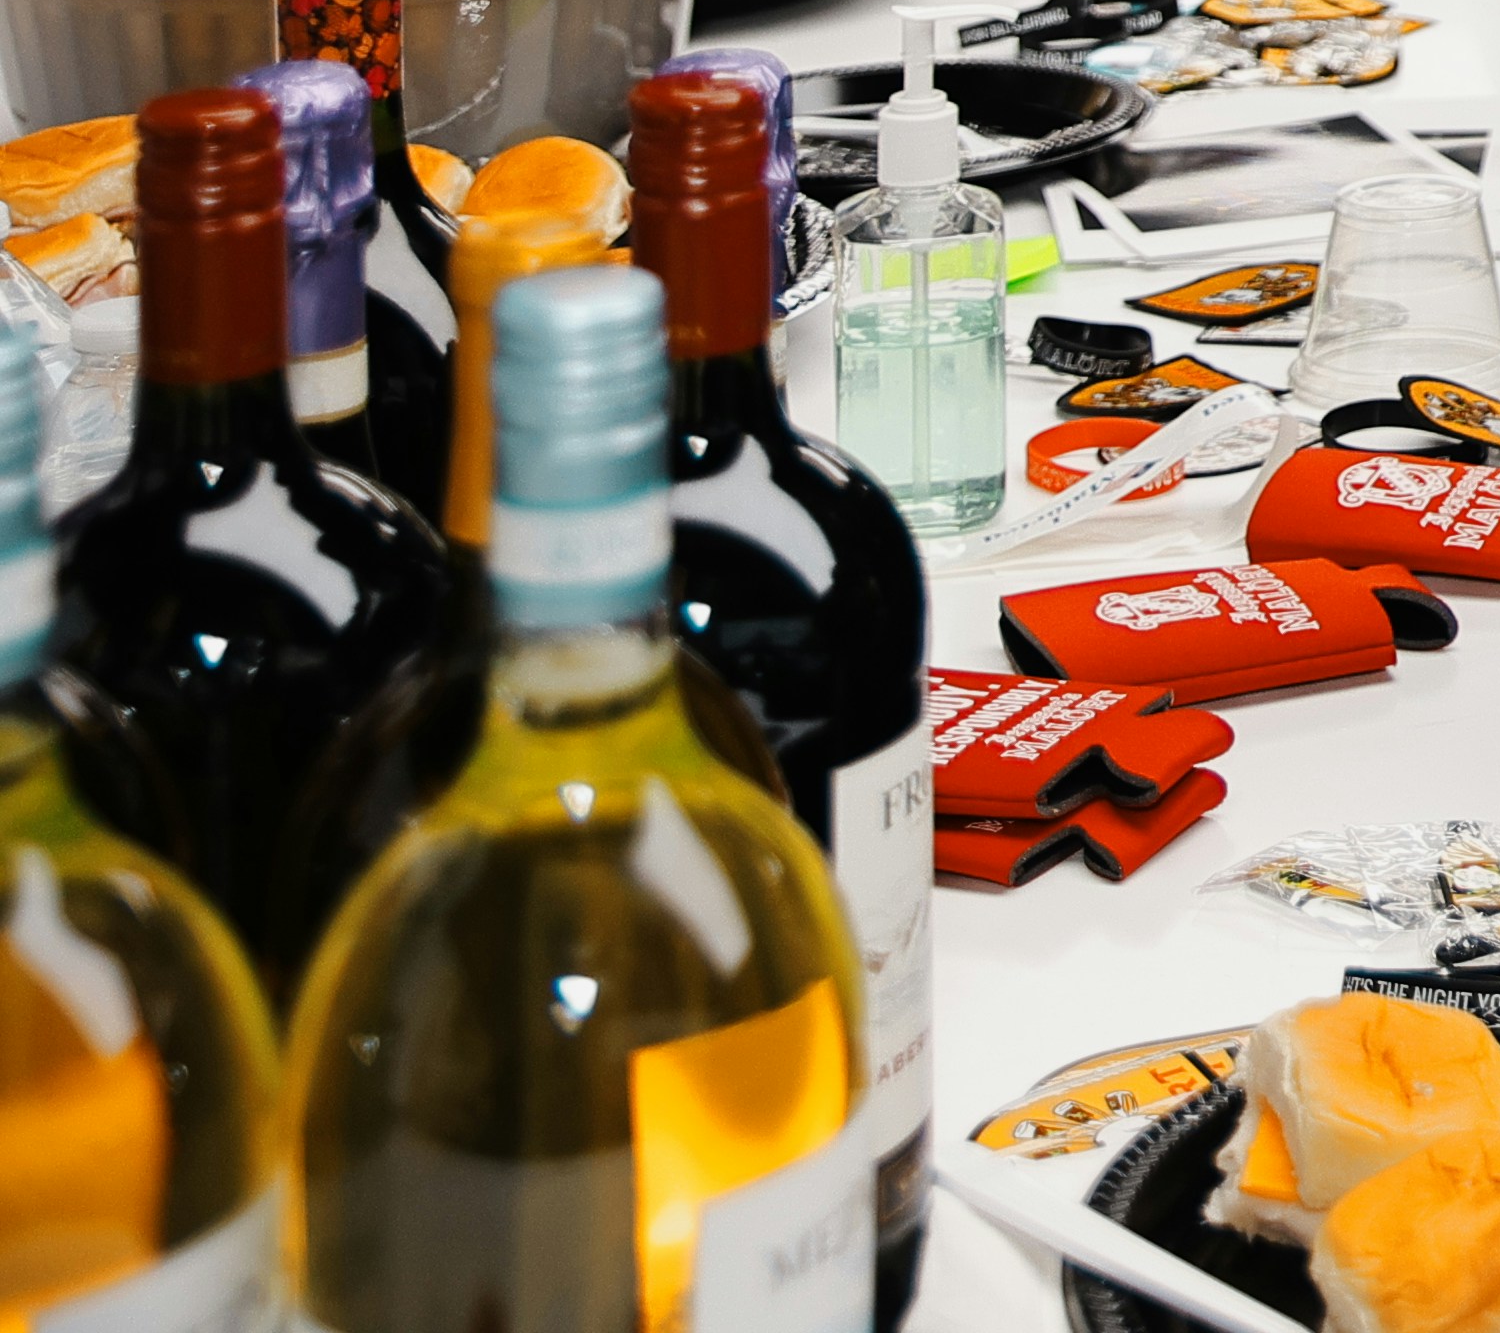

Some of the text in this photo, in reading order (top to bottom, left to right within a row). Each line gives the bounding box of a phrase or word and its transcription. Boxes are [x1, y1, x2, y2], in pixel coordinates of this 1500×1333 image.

[1000, 689, 1128, 761] MALÖRT
[1377, 980, 1410, 1000] THE
[1413, 985, 1473, 1012] NIGHT
